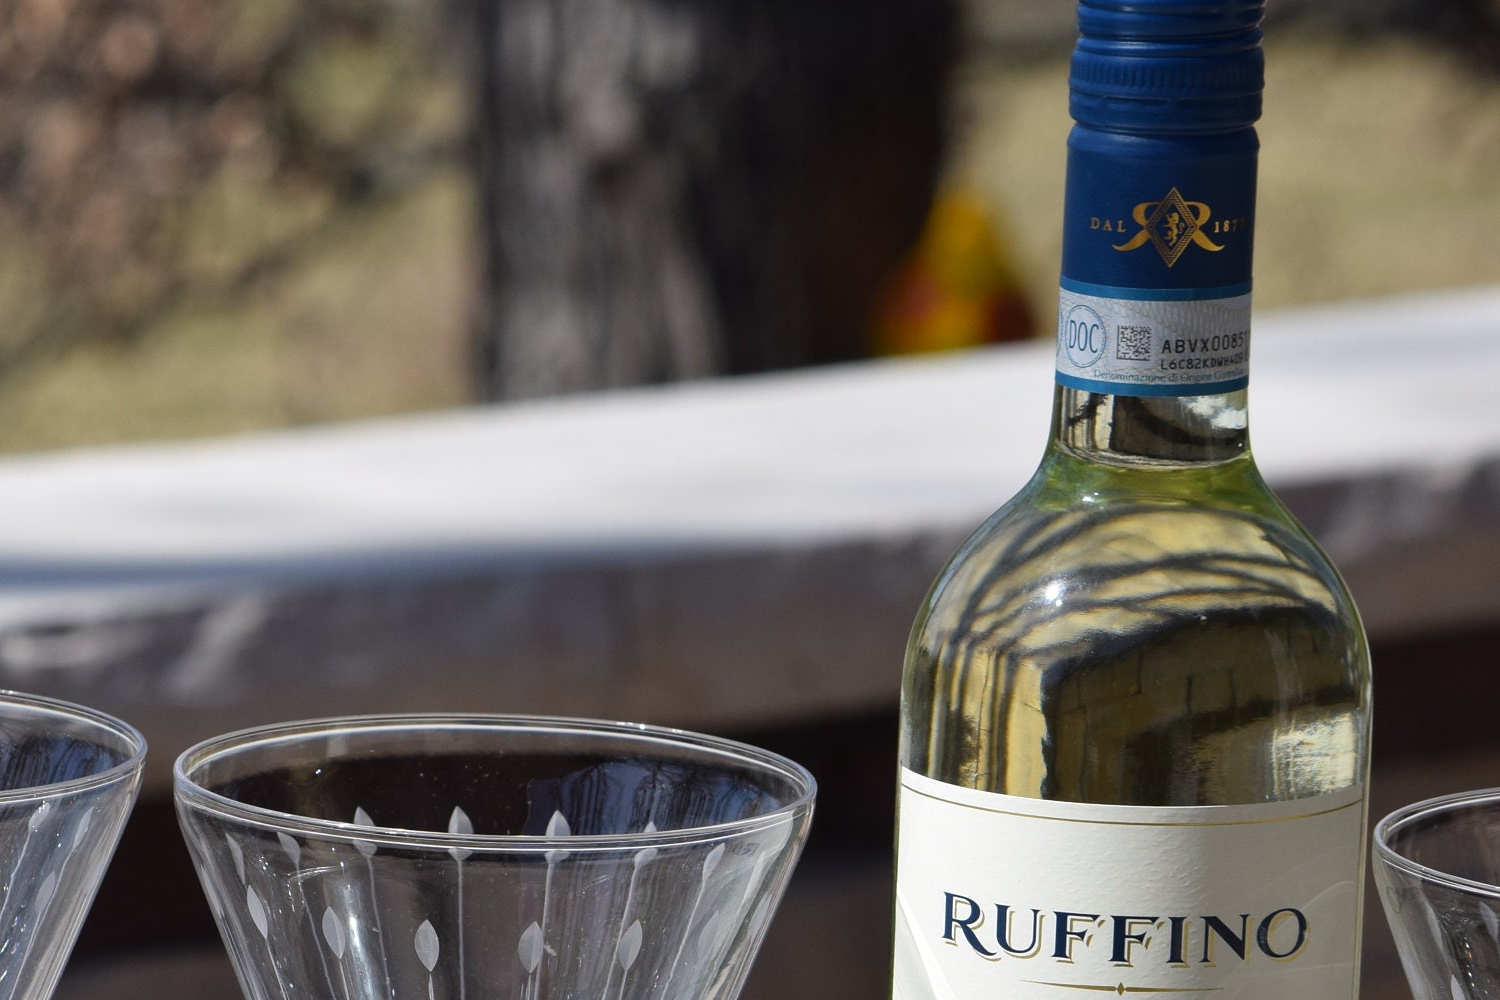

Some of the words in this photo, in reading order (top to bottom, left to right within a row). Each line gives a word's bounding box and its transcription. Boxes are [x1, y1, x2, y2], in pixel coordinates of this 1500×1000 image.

[1090, 217, 1126, 233] DAL
[1069, 319, 1100, 354] DOC
[942, 891, 1311, 968] RUFFINO
